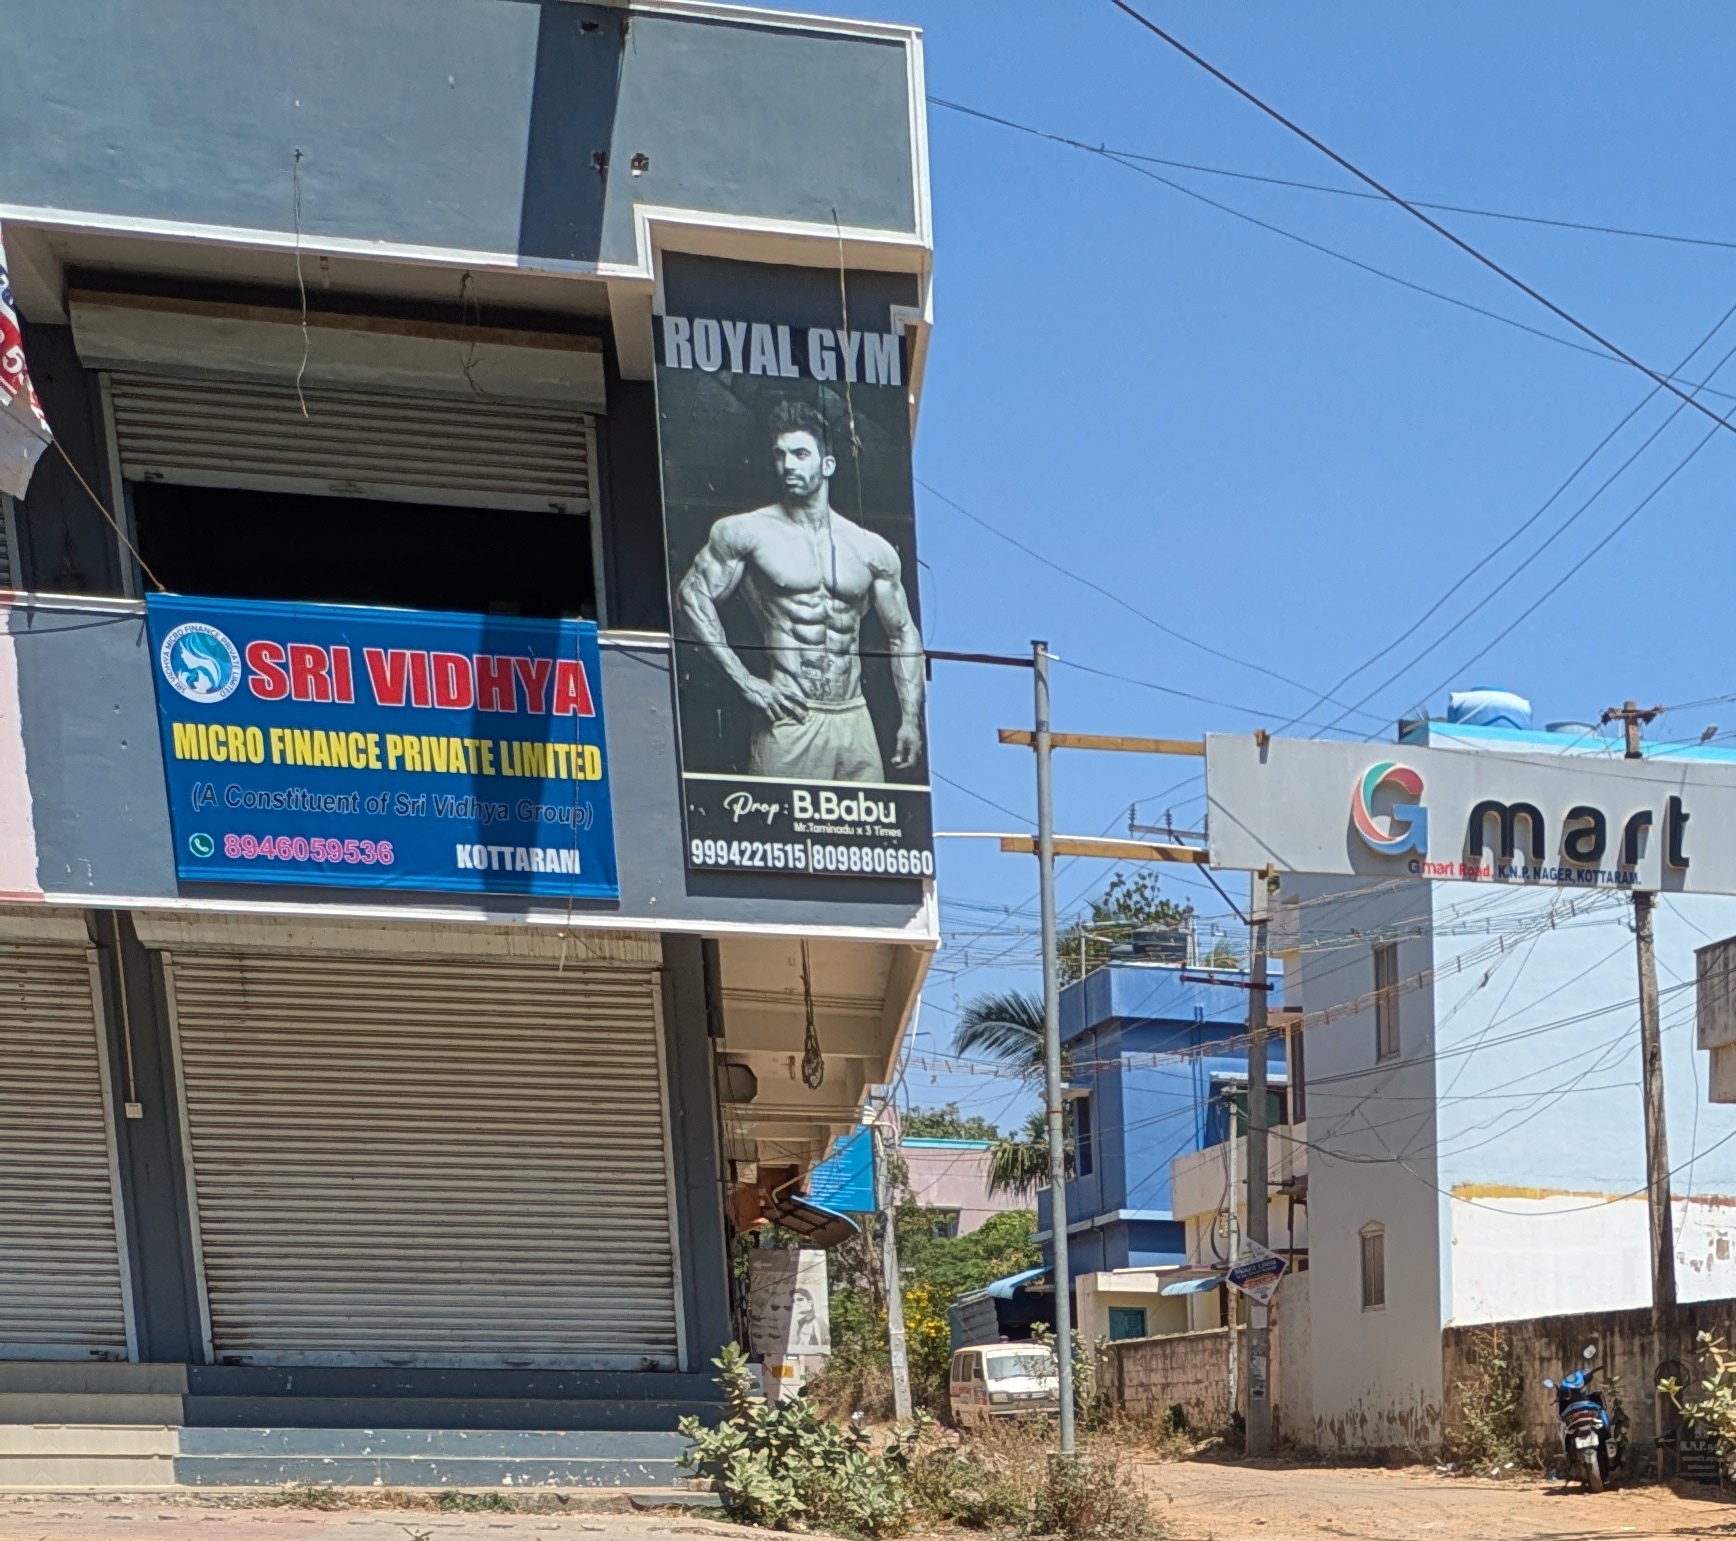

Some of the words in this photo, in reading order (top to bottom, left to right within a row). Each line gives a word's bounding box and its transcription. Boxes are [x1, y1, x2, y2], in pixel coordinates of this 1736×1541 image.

[662, 315, 800, 378] ROYAL
[807, 326, 902, 387] GYM
[245, 640, 355, 704] SRI
[363, 647, 596, 717] VIDHYA
[172, 722, 265, 765] MICRO
[269, 727, 382, 770] FINANCE
[385, 733, 496, 776] PRIVATE
[499, 741, 603, 781] LIMITED
[191, 782, 218, 812] (A
[224, 784, 359, 814] Constituent
[365, 791, 390, 815] of
[394, 792, 426, 817] Sri
[432, 794, 509, 825] Vidhya
[517, 799, 594, 831] Group)
[792, 789, 897, 823] B.Babu
[864, 825, 872, 836] 3
[223, 833, 395, 865] 8946059536
[1469, 795, 1690, 868] mart
[691, 838, 806, 869] 9994221515
[813, 845, 934, 875] 8098806660
